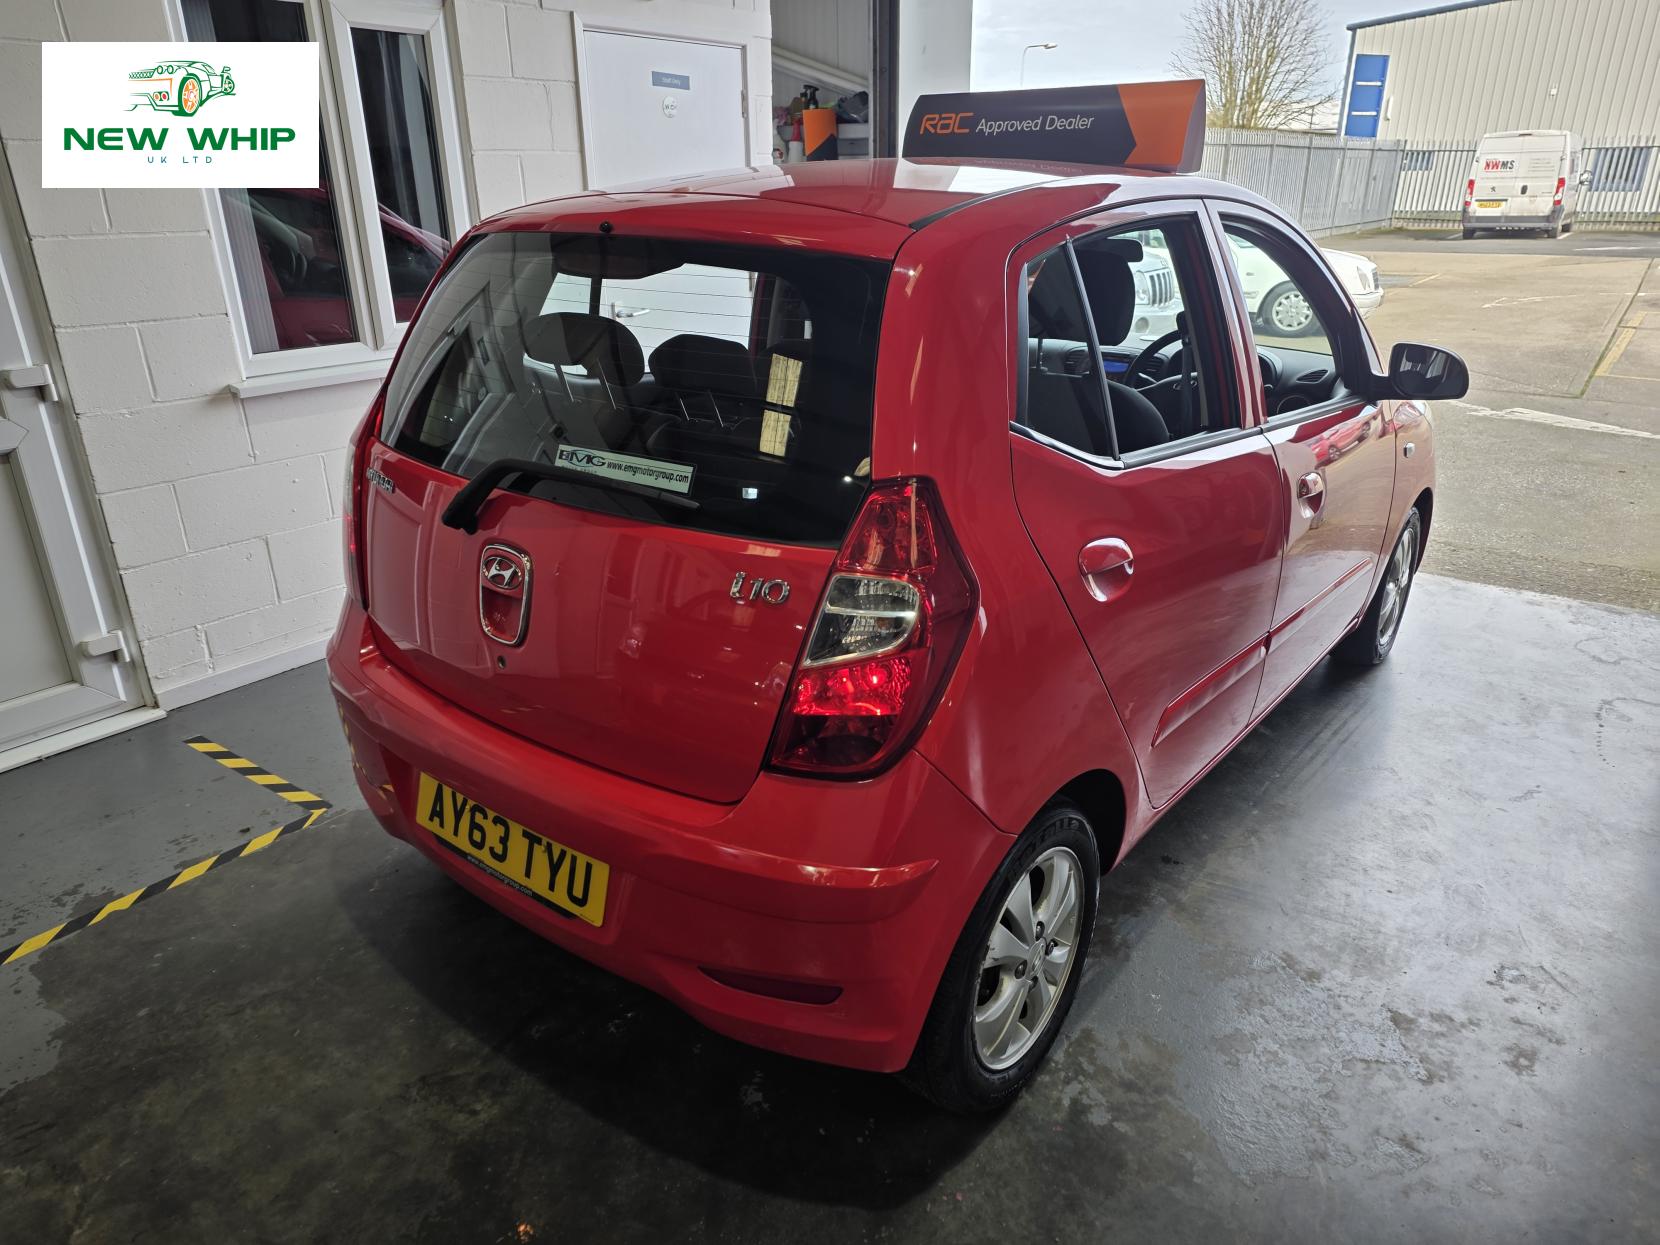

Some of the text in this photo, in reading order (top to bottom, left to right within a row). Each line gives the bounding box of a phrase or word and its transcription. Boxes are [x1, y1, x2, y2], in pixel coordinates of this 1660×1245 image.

[975, 115, 1043, 137] Approved
[1045, 114, 1095, 131] Dealer
[1484, 160, 1515, 171] NWMS
[606, 460, 690, 484] www.emgmotorgroup.com
[729, 571, 790, 604] i10
[428, 782, 593, 909] AY63 TYU
